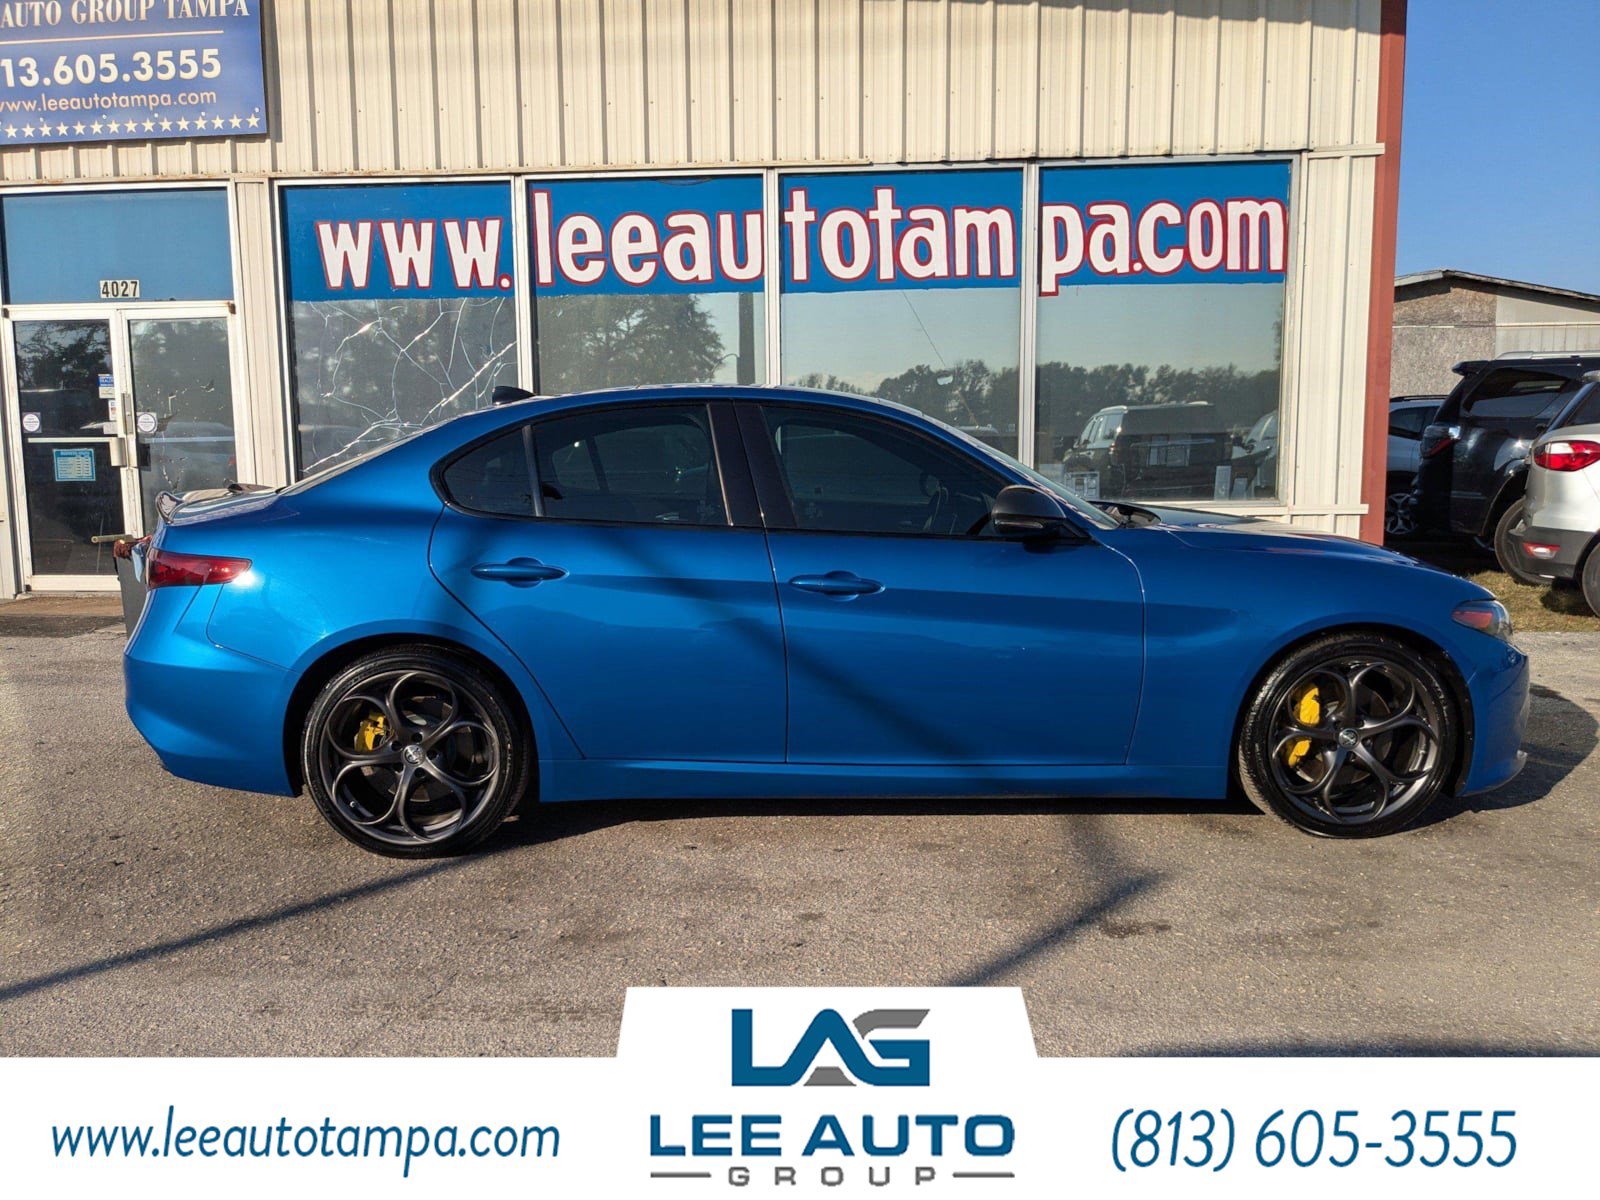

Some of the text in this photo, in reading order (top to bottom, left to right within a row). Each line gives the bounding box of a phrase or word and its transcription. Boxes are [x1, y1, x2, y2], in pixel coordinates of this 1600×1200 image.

[0, 0, 250, 29] AUTO GROUP TAMPA
[101, 280, 138, 298] 4027
